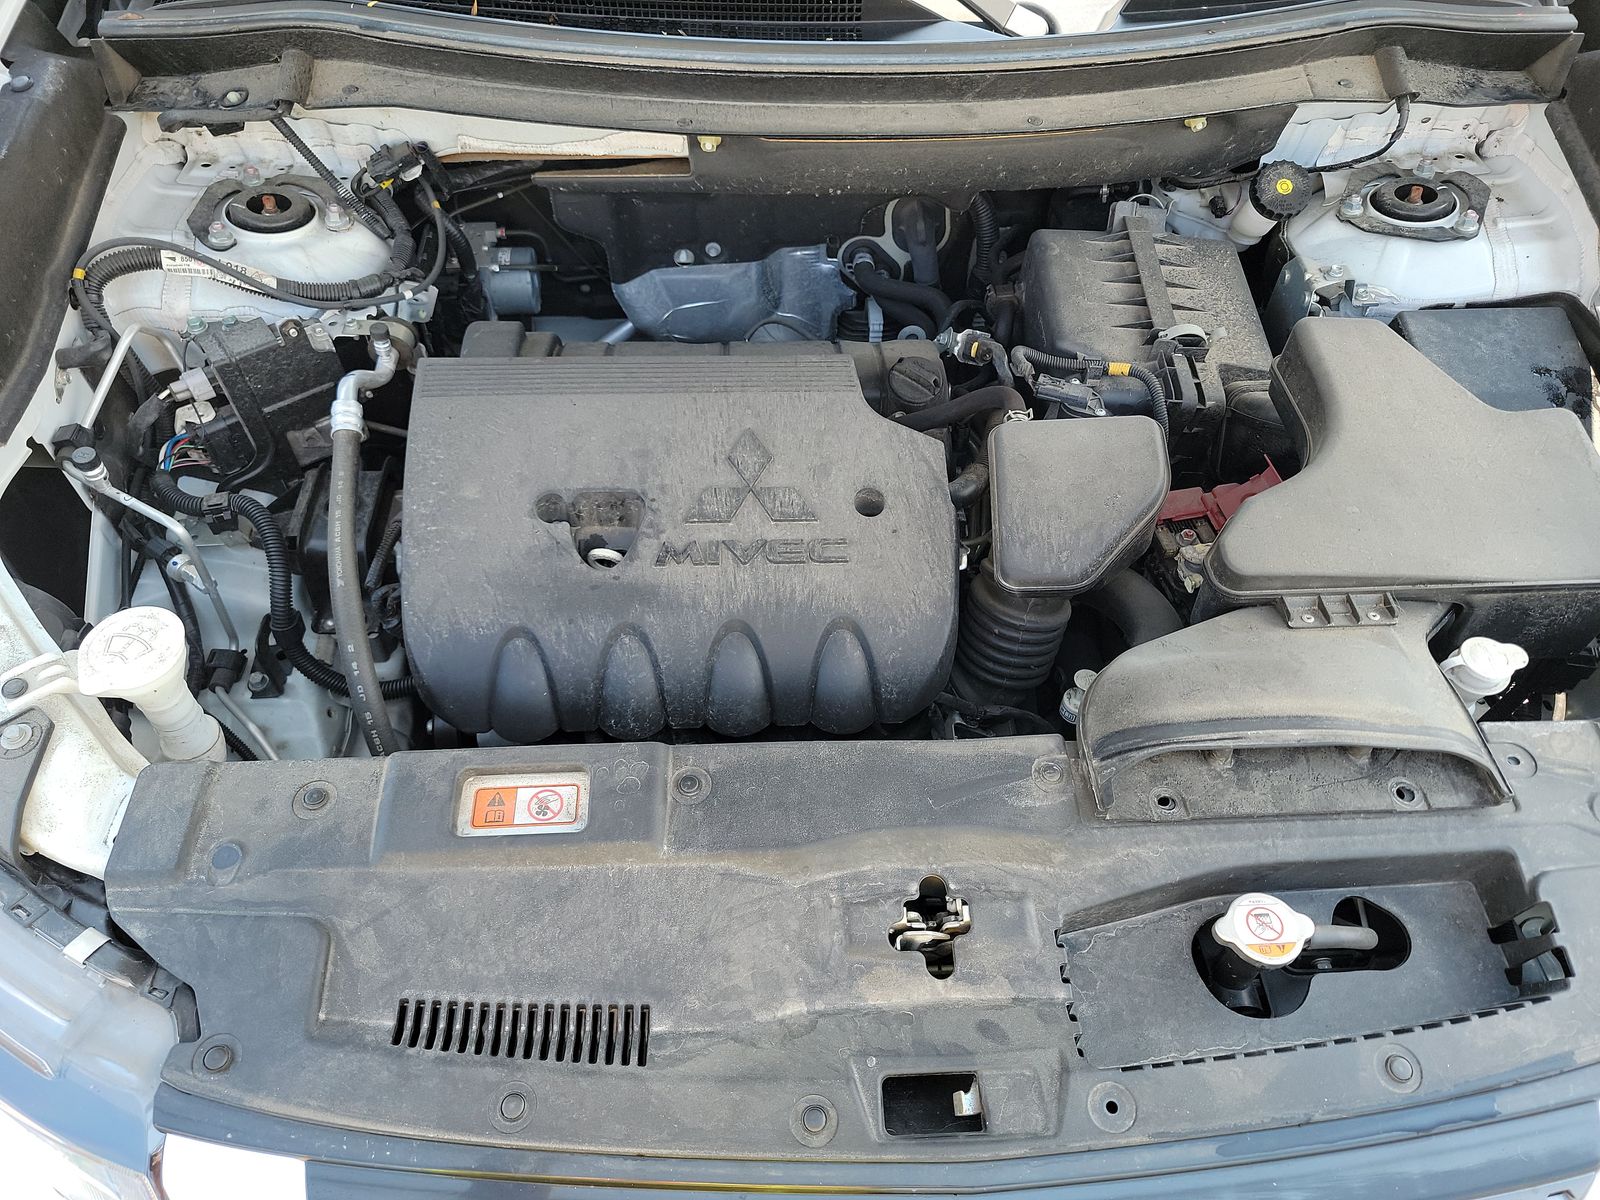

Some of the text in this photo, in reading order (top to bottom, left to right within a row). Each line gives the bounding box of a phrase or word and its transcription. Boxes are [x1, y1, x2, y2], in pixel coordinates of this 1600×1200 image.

[654, 538, 850, 567] MIVEC
[347, 643, 355, 653] 2
[356, 685, 366, 702] JD
